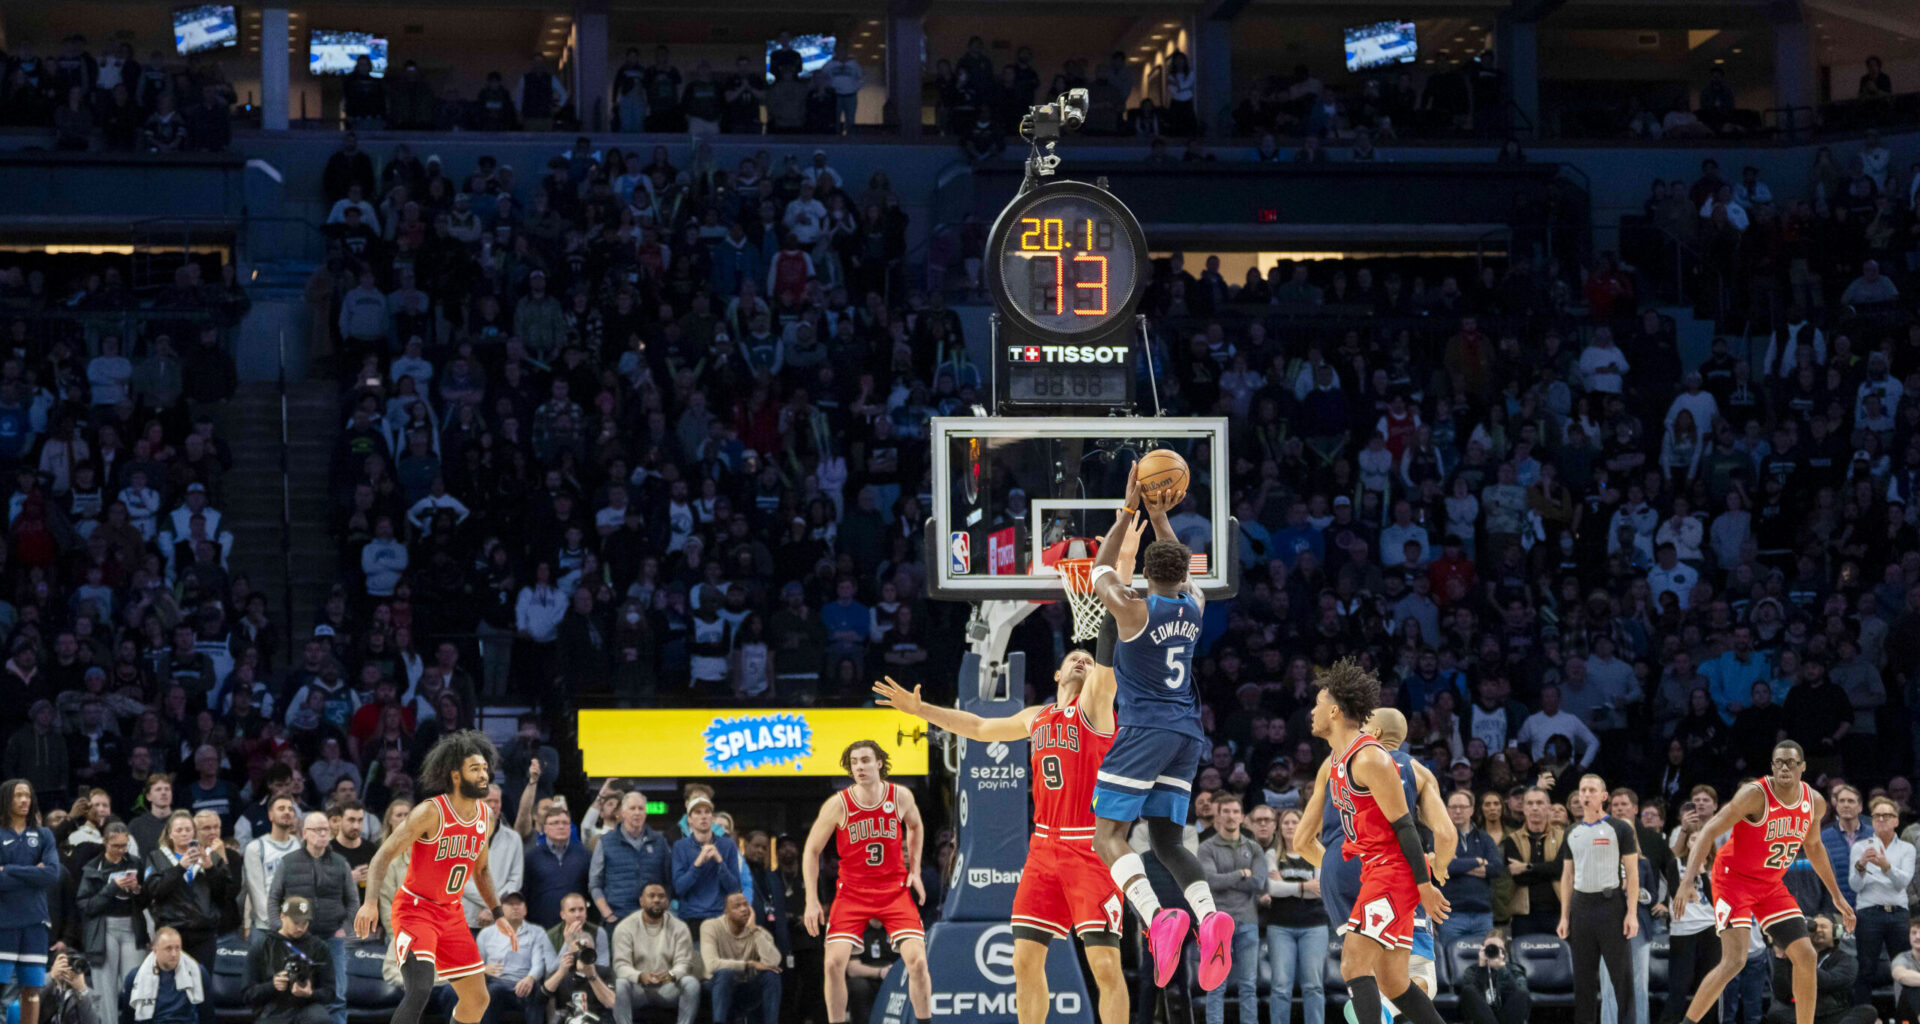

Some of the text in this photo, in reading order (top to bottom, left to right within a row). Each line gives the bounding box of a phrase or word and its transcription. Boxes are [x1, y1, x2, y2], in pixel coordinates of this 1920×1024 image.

[1021, 218, 1092, 250] 20.1
[1042, 346, 1128, 363] TISSOT
[1150, 620, 1199, 645] EDWARDS
[1165, 646, 1185, 689] 5
[713, 723, 803, 762] SPLASH
[970, 763, 1025, 779] sezzle
[978, 779, 1018, 791] pay in 4
[1041, 754, 1064, 790] 9
[847, 816, 897, 845] BULLS
[865, 842, 885, 867] 3
[1763, 841, 1801, 870] 25
[445, 864, 468, 895] 0
